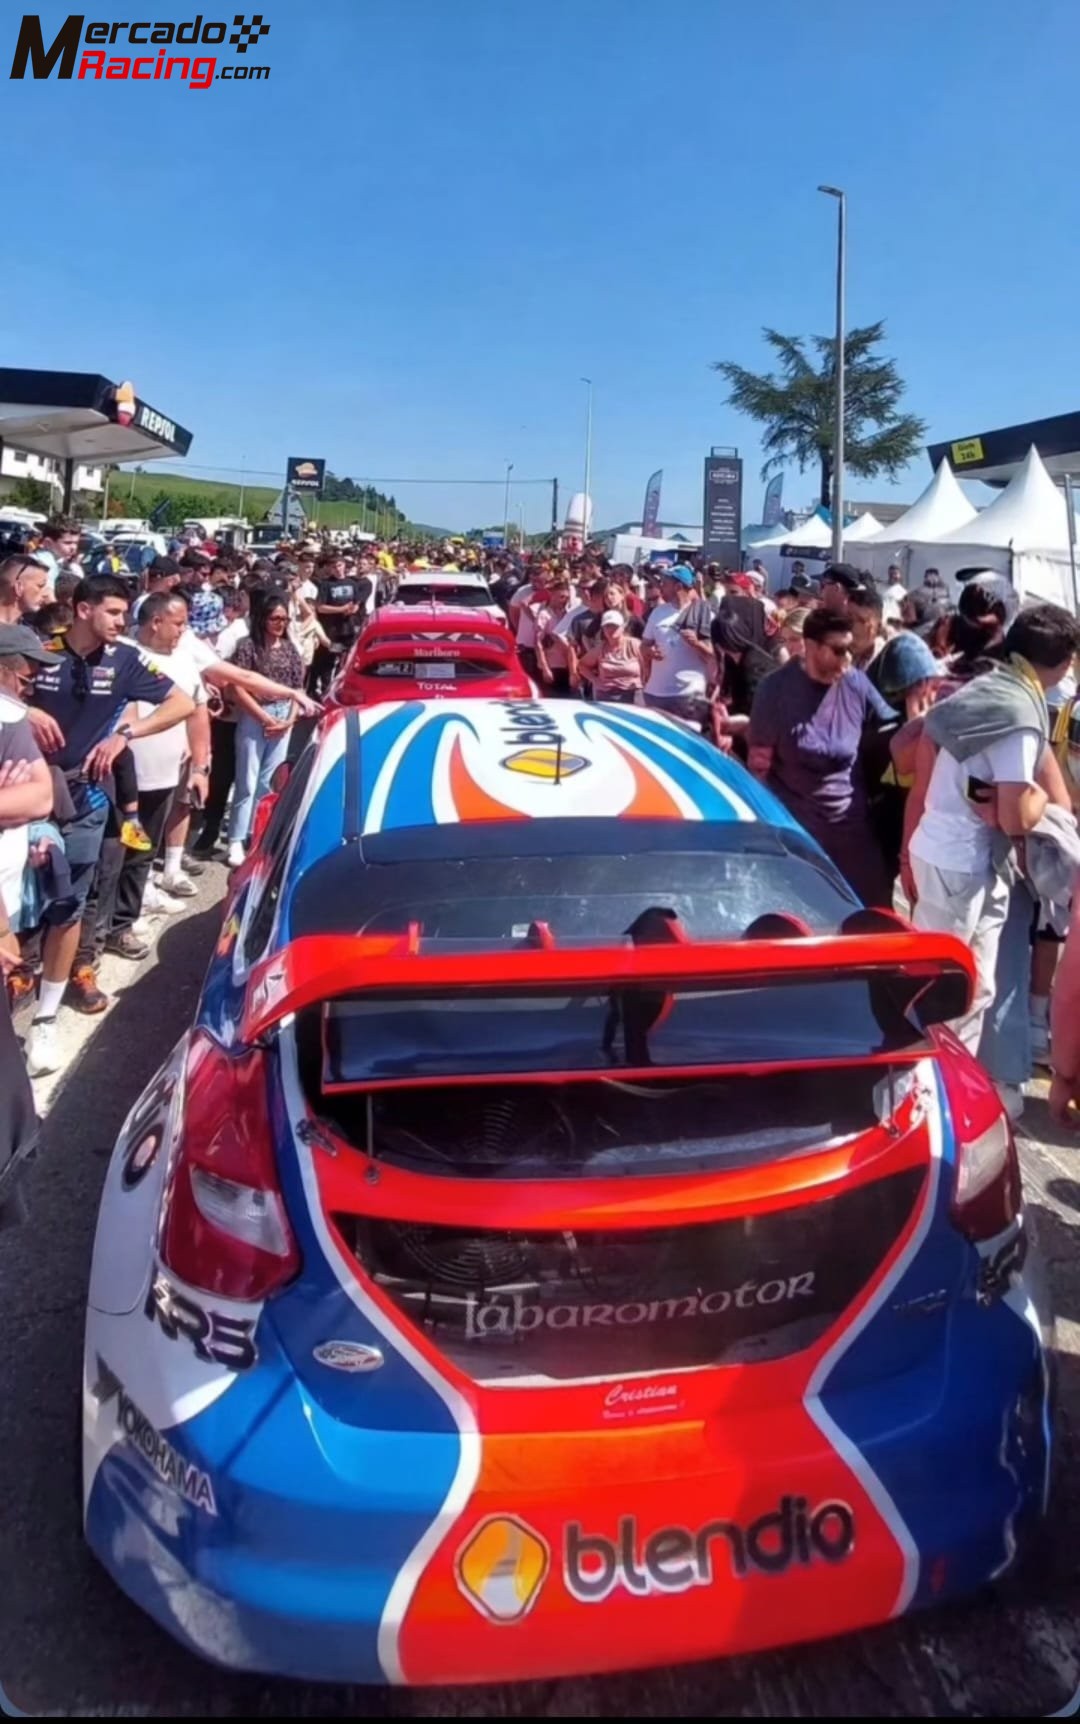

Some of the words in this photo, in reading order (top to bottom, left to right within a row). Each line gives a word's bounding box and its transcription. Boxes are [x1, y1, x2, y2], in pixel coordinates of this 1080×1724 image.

[140, 405, 176, 443] REPSOL
[413, 647, 461, 658] Marlboro
[416, 681, 458, 691] TOTAL
[116, 1389, 219, 1517] YOKOHAMA
[564, 1494, 856, 1603] blendio
